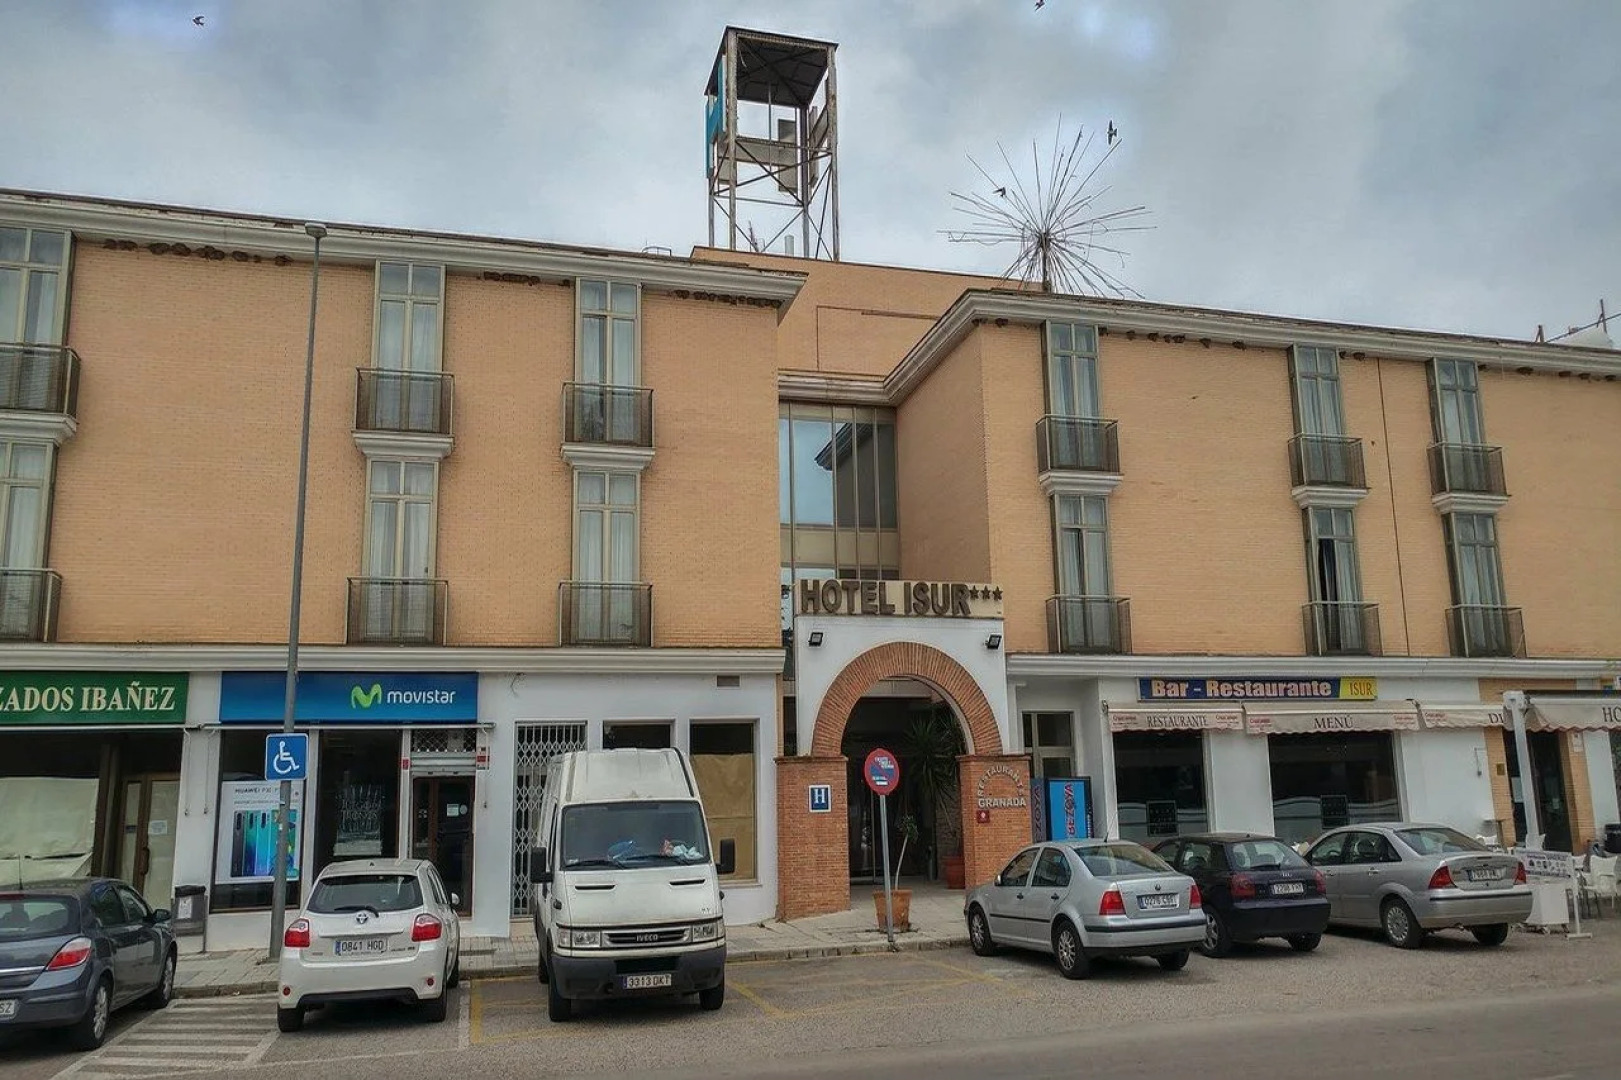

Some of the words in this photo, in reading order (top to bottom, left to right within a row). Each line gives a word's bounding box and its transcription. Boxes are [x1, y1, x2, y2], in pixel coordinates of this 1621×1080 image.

[800, 579, 895, 615] HOTEL
[904, 582, 971, 616] ISUR
[1152, 680, 1188, 698] Bar
[1206, 680, 1332, 697] Restaurante
[1350, 681, 1373, 696] ISUR
[0, 686, 74, 712] ADOS
[80, 681, 175, 711] IBAÑEZ
[387, 690, 456, 704] movistar
[1147, 715, 1209, 728] RESTAURANTE
[1314, 716, 1354, 729] MENÚ
[813, 789, 826, 804] H
[978, 798, 1027, 808] GRANADA
[636, 933, 659, 942] IVECO
[341, 941, 362, 952] 0841
[628, 976, 652, 986] 3313
